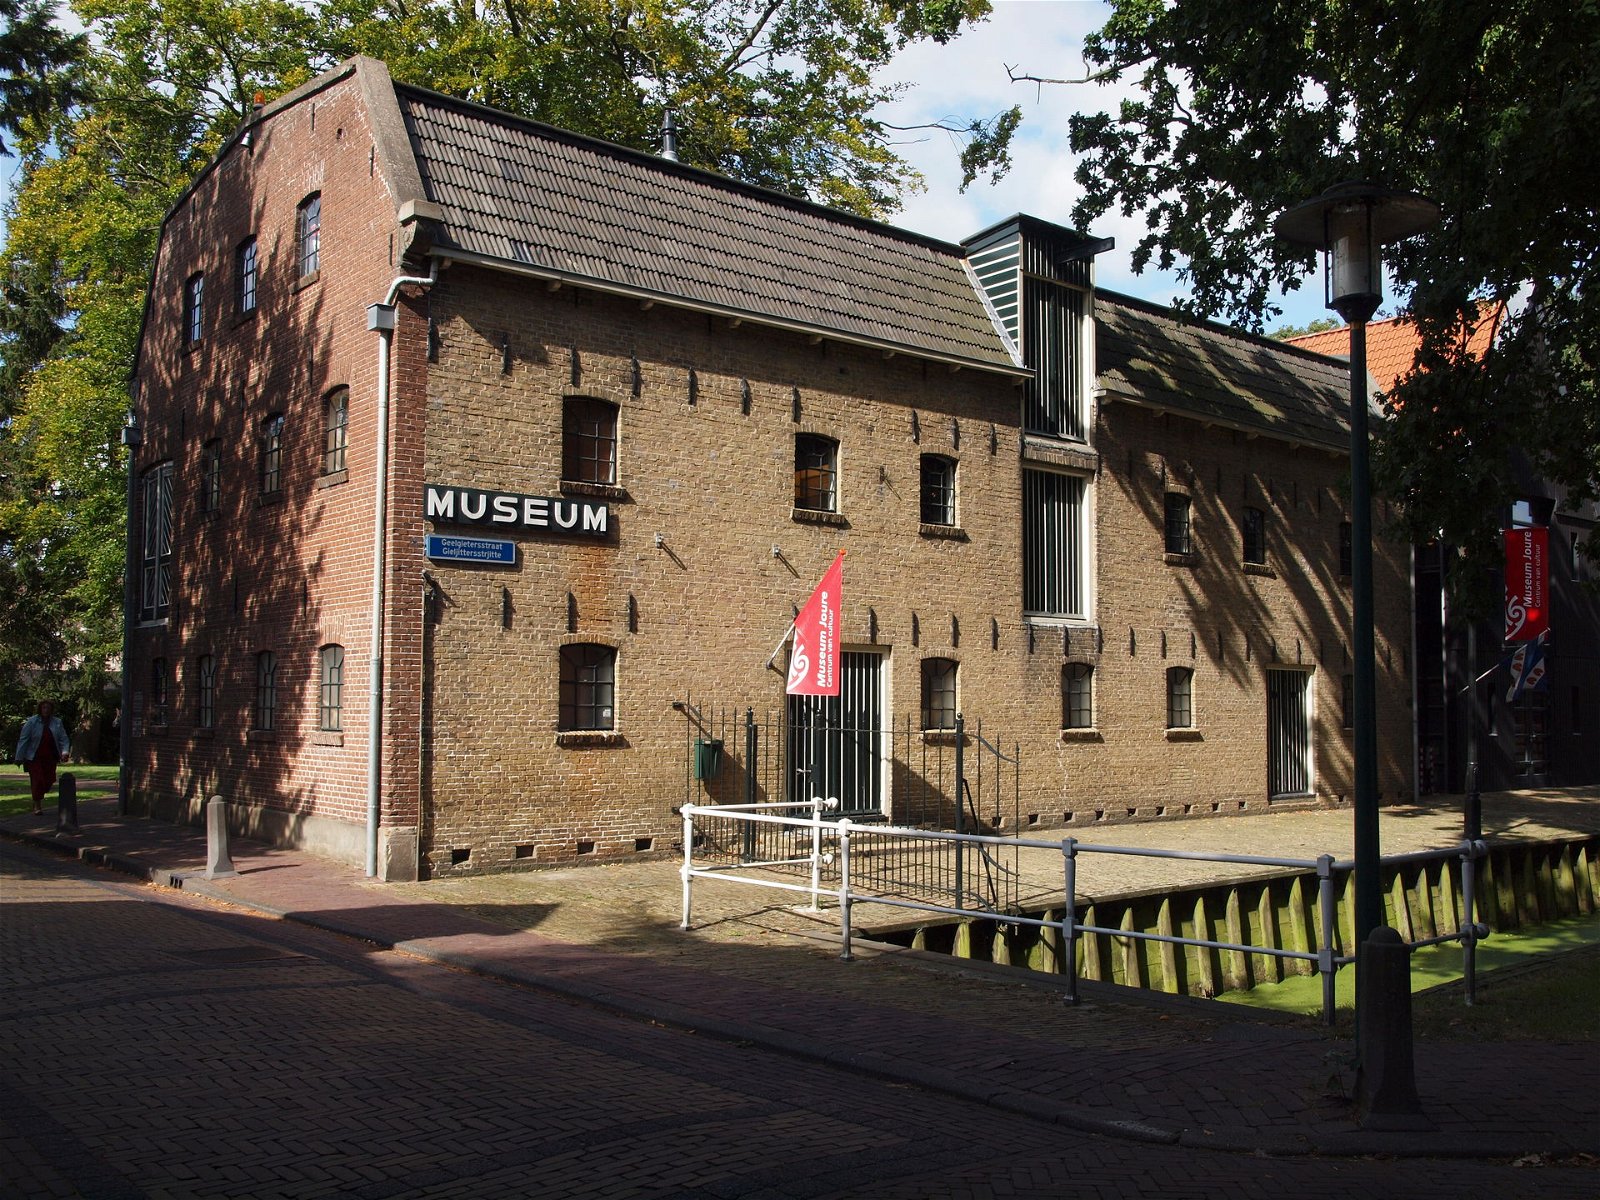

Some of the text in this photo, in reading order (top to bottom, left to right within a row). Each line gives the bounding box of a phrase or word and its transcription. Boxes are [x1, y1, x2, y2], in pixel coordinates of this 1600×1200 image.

[427, 488, 607, 532] MUSEUM
[441, 538, 503, 551] Geelgietersstraat
[1523, 531, 1532, 608] Museum Joure
[817, 591, 828, 688] Museum Joure
